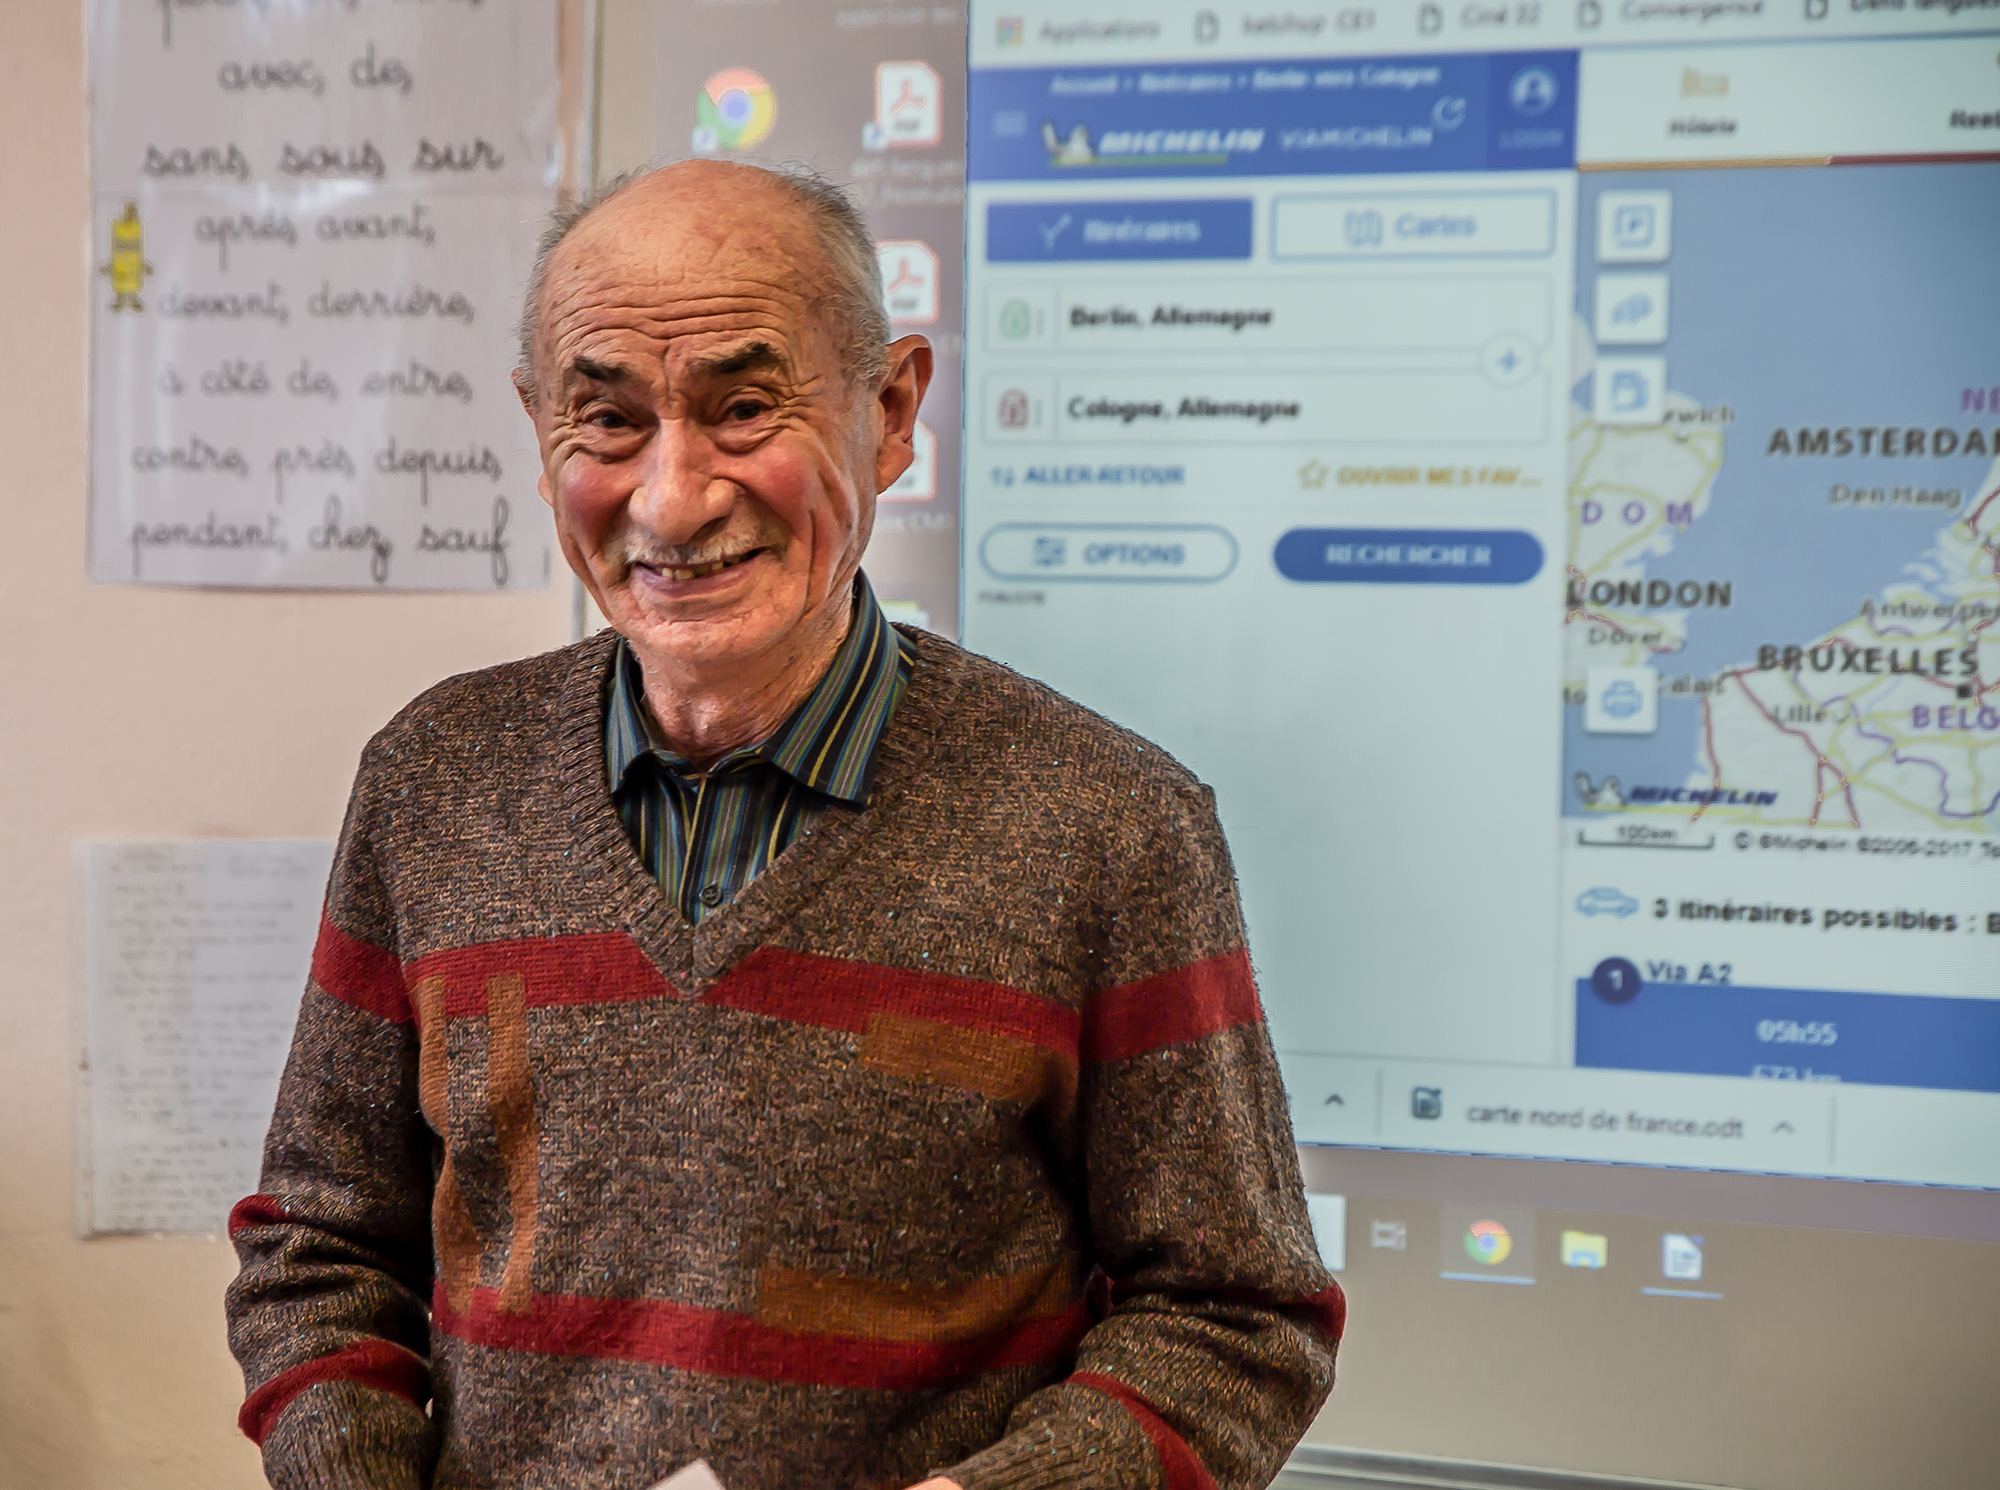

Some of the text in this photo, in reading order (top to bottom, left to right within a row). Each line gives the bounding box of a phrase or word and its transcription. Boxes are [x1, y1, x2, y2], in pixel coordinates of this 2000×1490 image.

[1098, 126, 1434, 154] MICHELIN VIAMICHELIN
[1393, 213, 1478, 239] Cartes
[1069, 306, 1274, 332] Berlin, Allemagne
[1068, 396, 1303, 423] Cologne, Allemagne
[1663, 403, 1736, 425] rwich
[1829, 484, 1963, 509] Den Haag
[1083, 544, 1186, 566] OPTIONS
[1324, 543, 1492, 568] RECHERCHER
[1566, 580, 1733, 609] LONDON
[1588, 628, 1663, 647] Dover
[1756, 644, 1979, 676] BRUXELLES
[1773, 705, 1829, 725] Lille
[1628, 785, 1778, 807] MICHELIN
[1653, 898, 1669, 919] 3
[1822, 907, 1959, 933] possibles
[1607, 968, 1625, 991] 1
[1646, 960, 1736, 986] Via A2
[1755, 1019, 1839, 1047] 05h55
[1466, 1102, 1744, 1140] carte nord de france.odt
